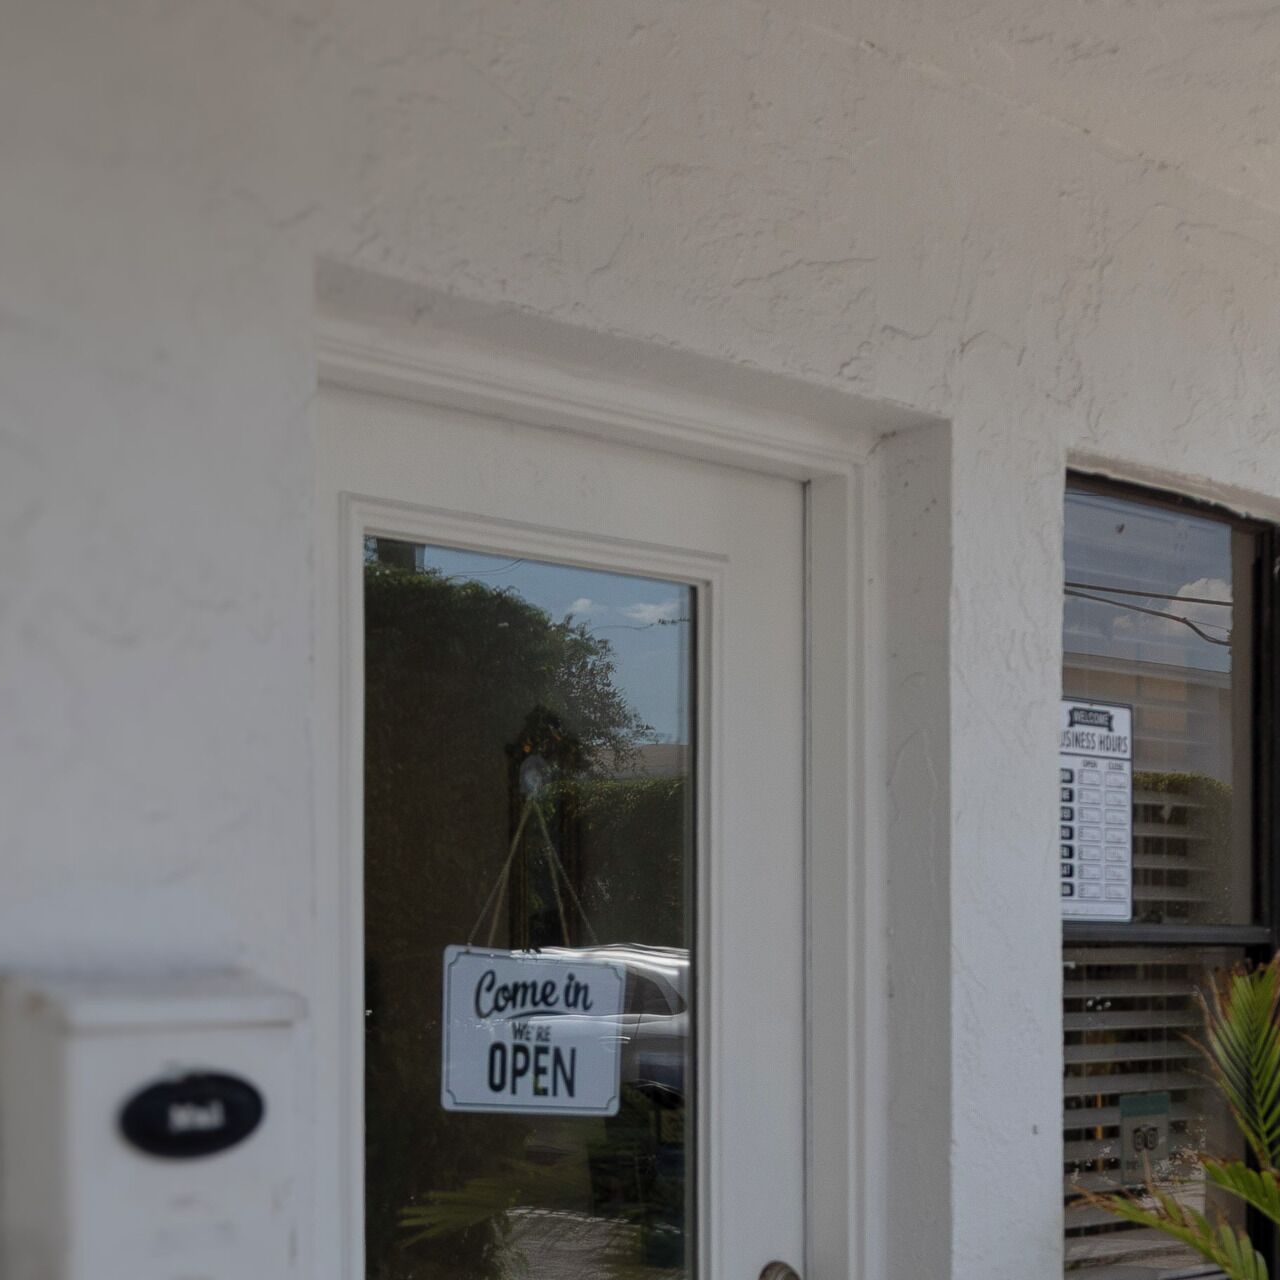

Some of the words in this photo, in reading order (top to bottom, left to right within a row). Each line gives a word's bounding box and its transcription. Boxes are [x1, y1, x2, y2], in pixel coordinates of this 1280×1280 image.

[1073, 710, 1110, 726] WELCOME
[1060, 730, 1097, 750] USINESS
[1098, 734, 1128, 753] HOURS
[474, 969, 559, 1019] Come
[563, 972, 593, 1012] in
[512, 1022, 552, 1042] WE'RE
[487, 1041, 577, 1098] OPEN
